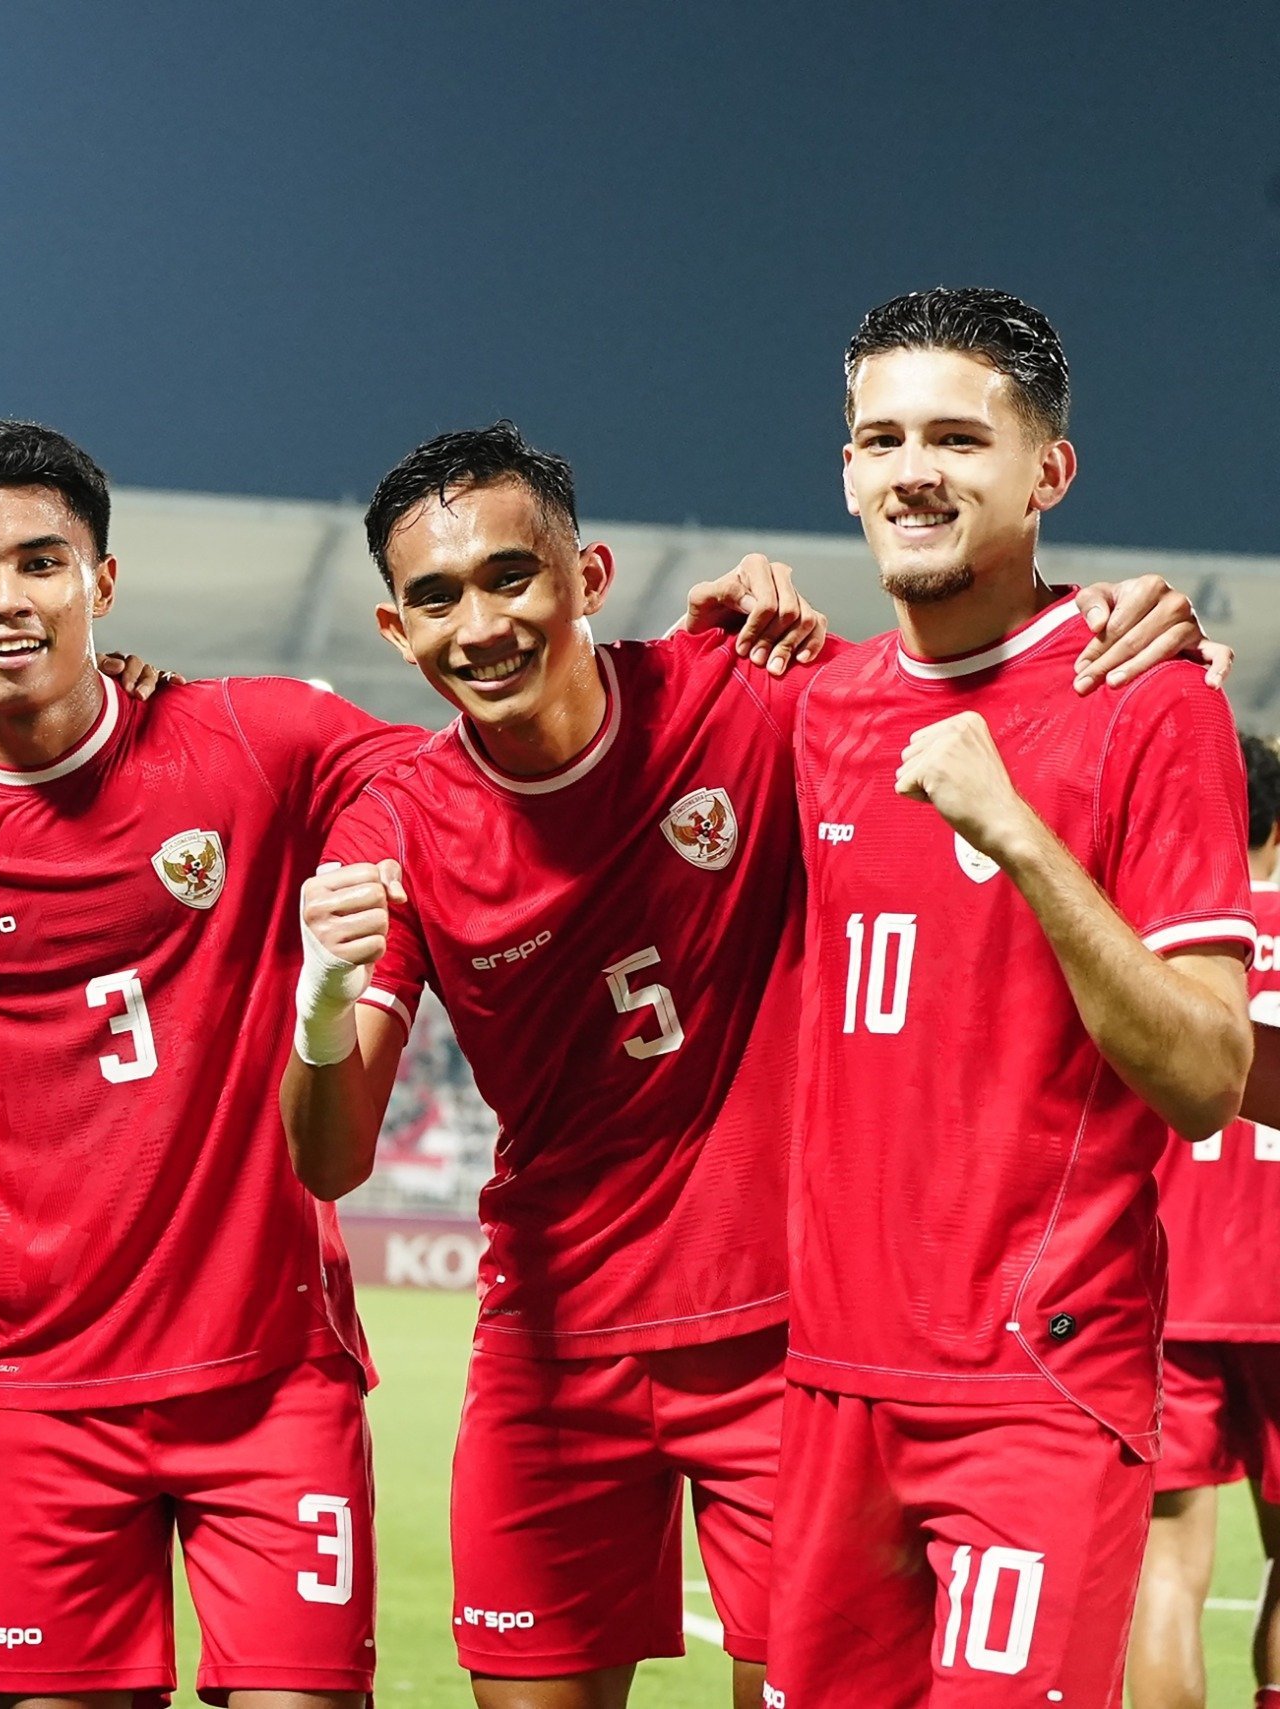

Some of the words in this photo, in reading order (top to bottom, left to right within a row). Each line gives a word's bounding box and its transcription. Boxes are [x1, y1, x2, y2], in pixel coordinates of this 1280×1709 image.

[471, 930, 552, 970] erspo
[602, 946, 684, 1060] 5
[843, 913, 918, 1034] 10
[86, 969, 158, 1084] 3
[385, 1232, 490, 1289] KO
[297, 1494, 353, 1605] 3
[464, 1606, 534, 1633] erspo
[941, 1545, 1045, 1675] 10
